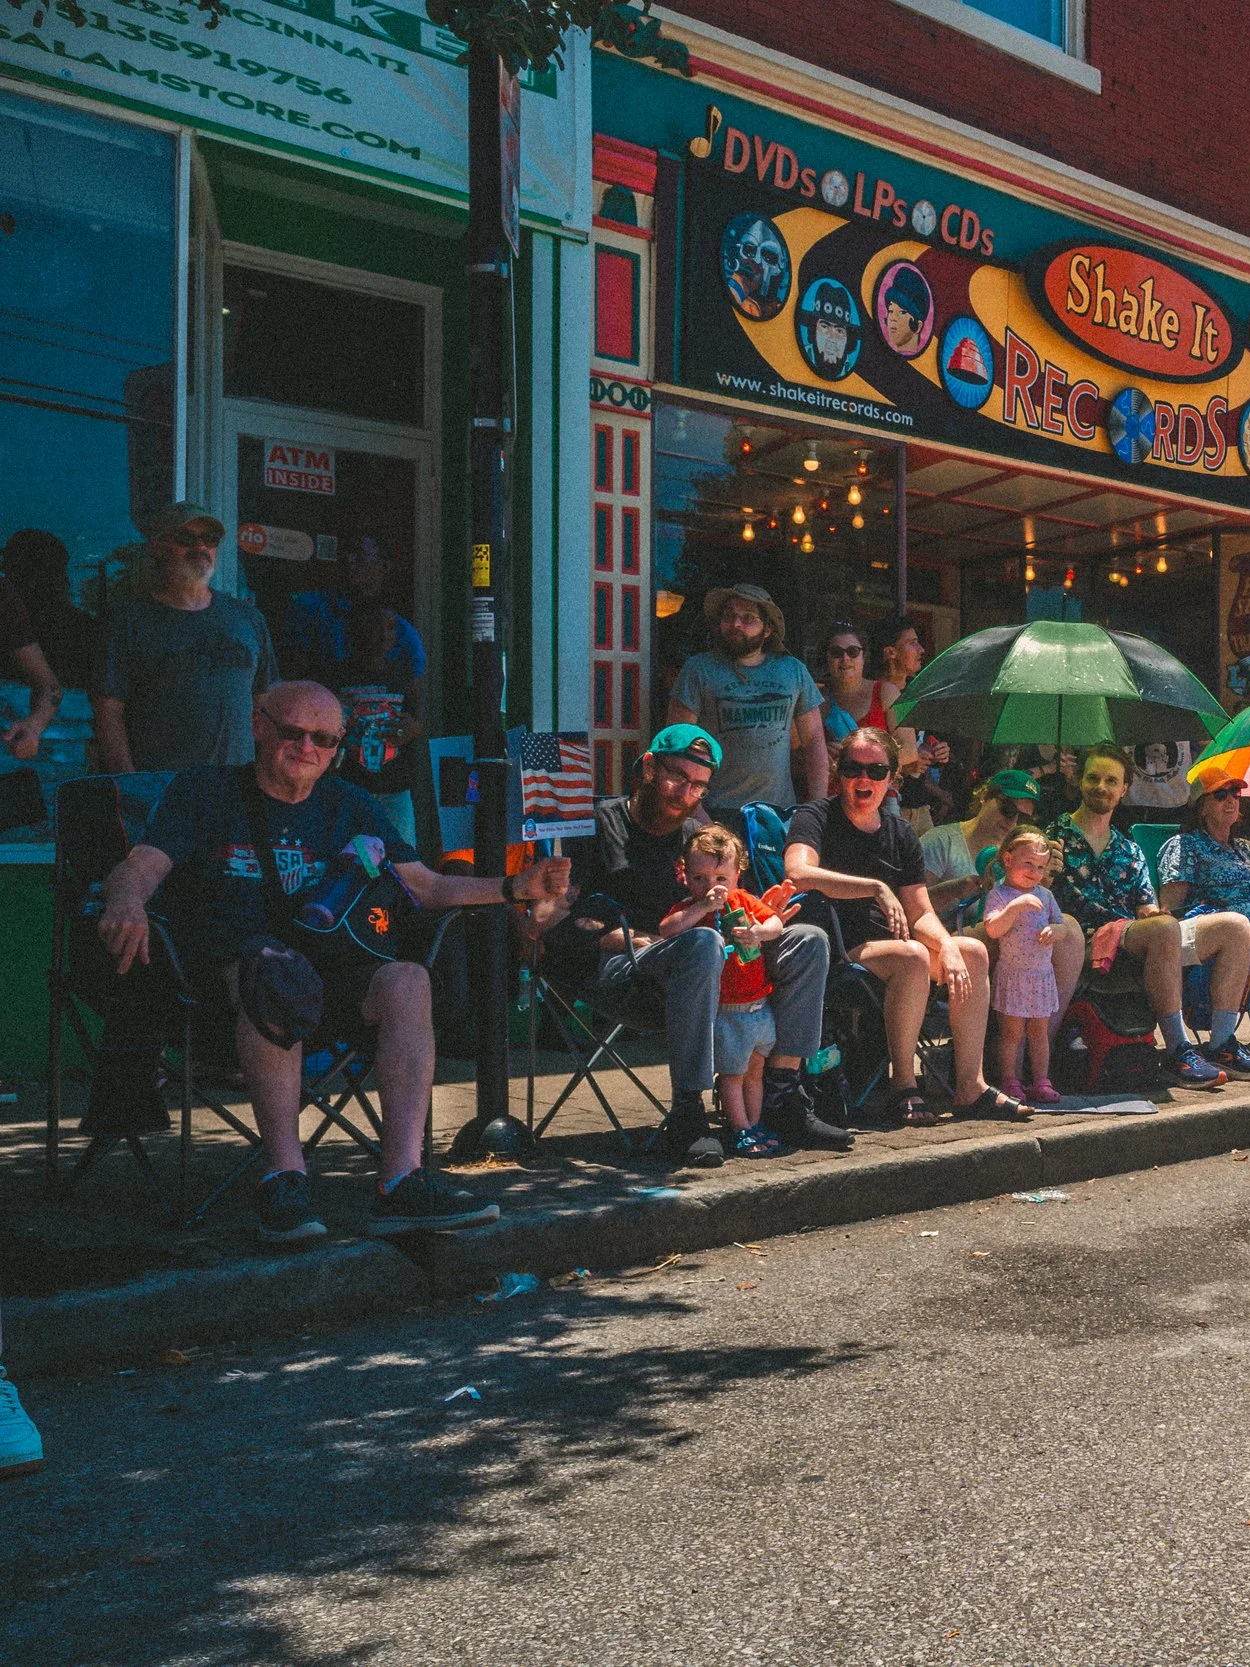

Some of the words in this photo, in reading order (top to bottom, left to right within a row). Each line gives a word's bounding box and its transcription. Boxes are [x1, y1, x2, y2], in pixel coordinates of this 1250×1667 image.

[180, 0, 410, 76] CINNATI
[723, 127, 816, 199] DVDs
[852, 172, 907, 228] LPs
[940, 203, 995, 257] CDs
[1066, 253, 1180, 347] Shake
[1190, 302, 1220, 363] It
[268, 445, 331, 471] ATM
[266, 469, 333, 493] INSIDE
[241, 527, 264, 545] ria
[722, 705, 787, 725] MAMMOTH
